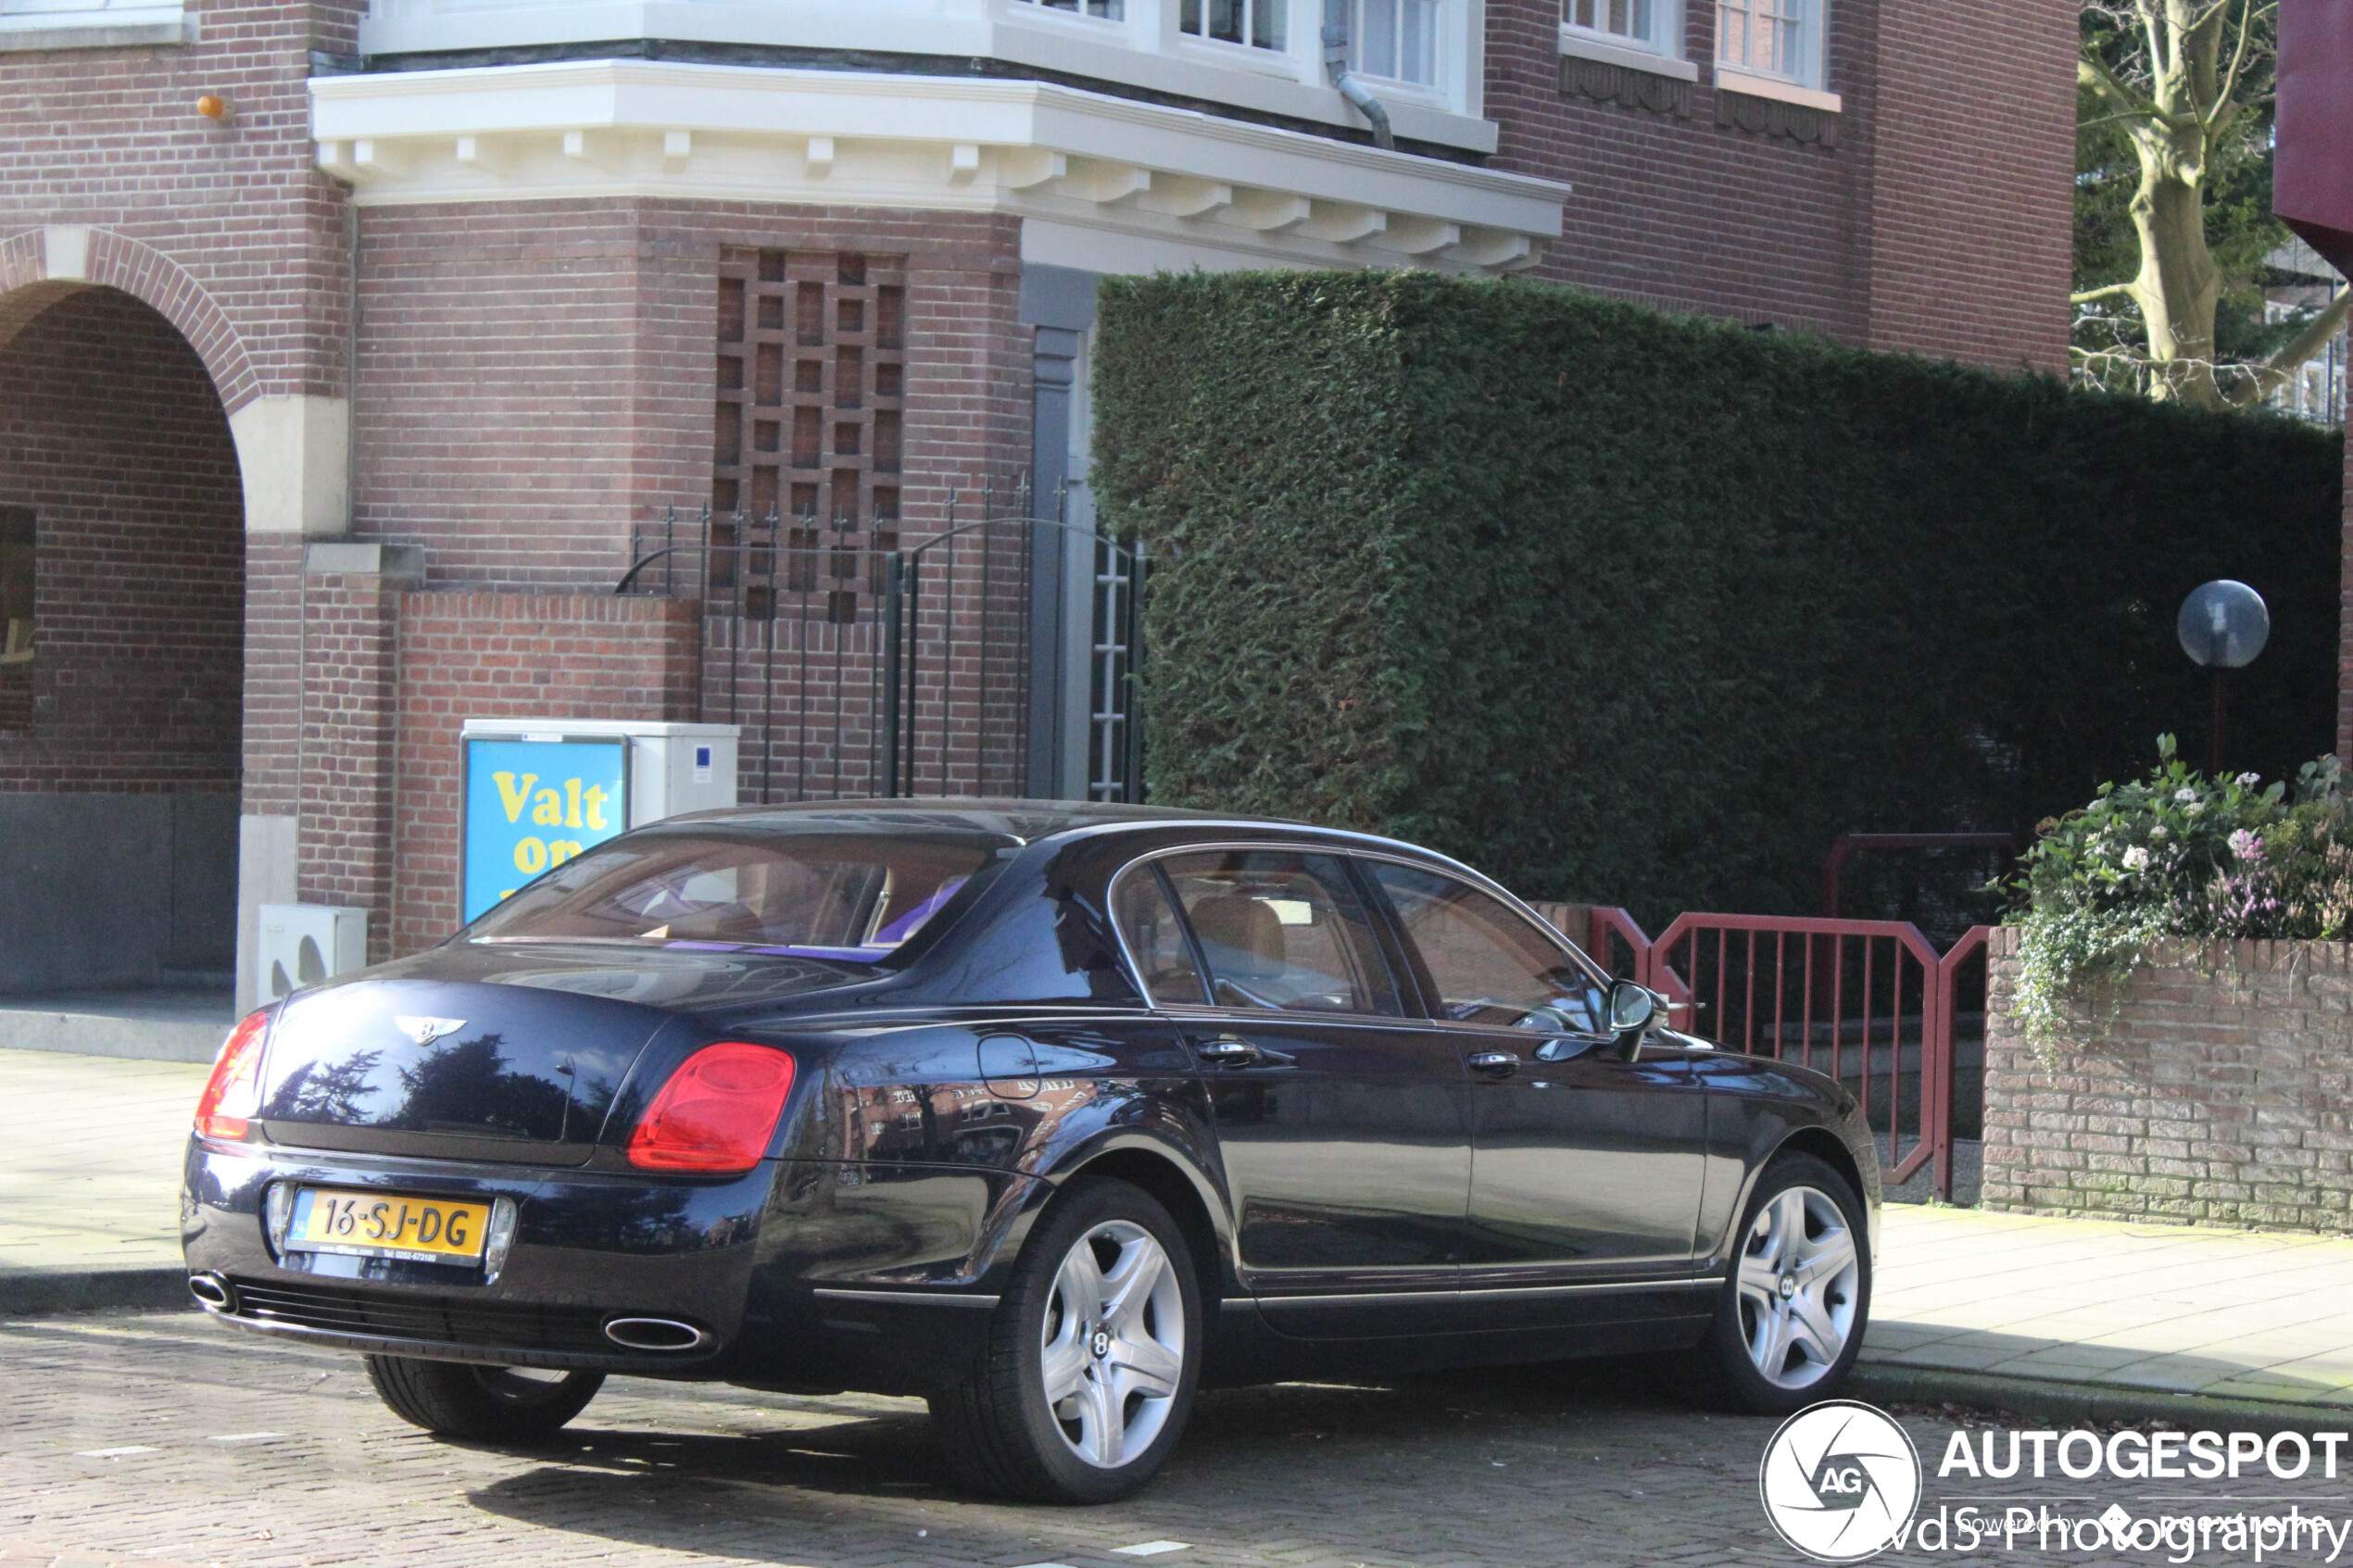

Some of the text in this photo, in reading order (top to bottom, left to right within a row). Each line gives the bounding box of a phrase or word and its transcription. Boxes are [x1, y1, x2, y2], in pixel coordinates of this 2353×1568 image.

[492, 771, 608, 830] Valt
[324, 1198, 469, 1247] 16-SJ-DG
[384, 1248, 395, 1259] Tel:
